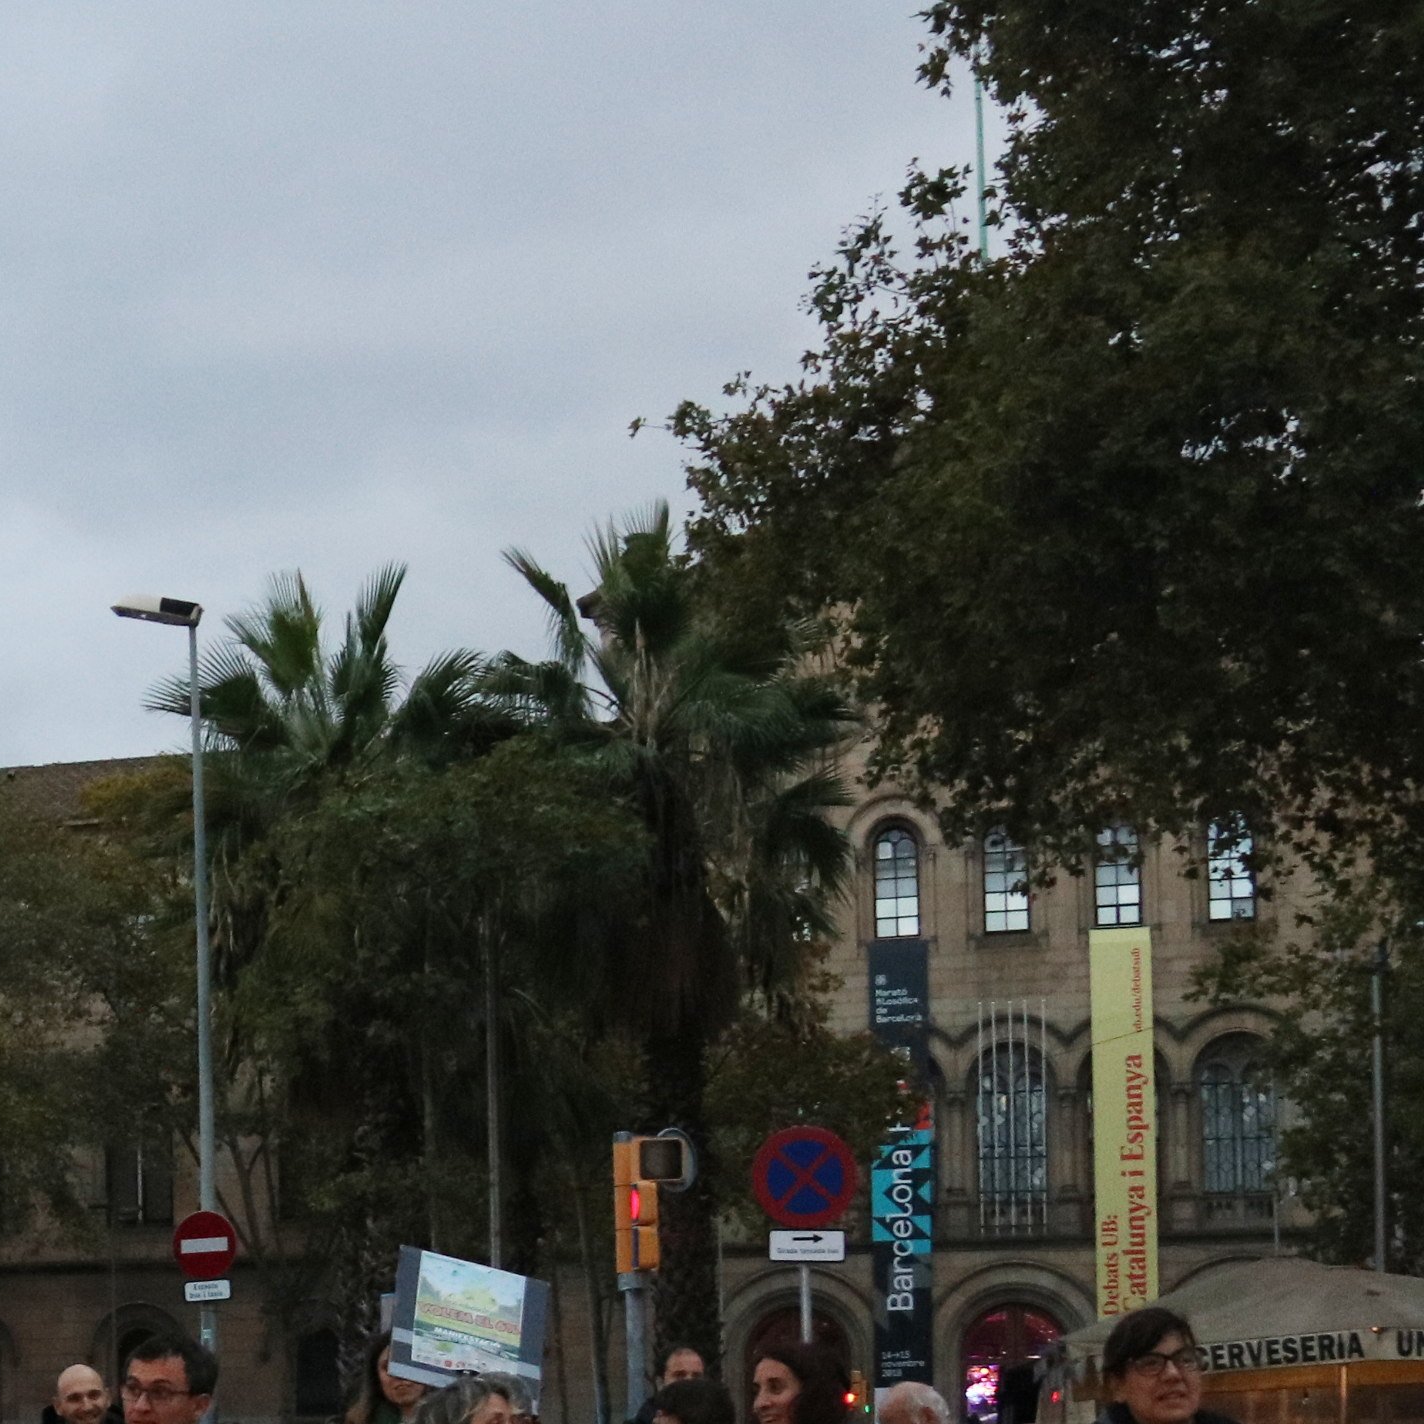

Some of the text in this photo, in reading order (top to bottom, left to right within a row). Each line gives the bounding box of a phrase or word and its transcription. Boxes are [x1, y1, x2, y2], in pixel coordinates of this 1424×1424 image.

[886, 1150, 915, 1311] Barcelona
[1119, 1054, 1152, 1312] Catalunya i Espanya
[1102, 1215, 1119, 1316] Debats UB:
[1196, 1331, 1365, 1371] CERVESERIA
